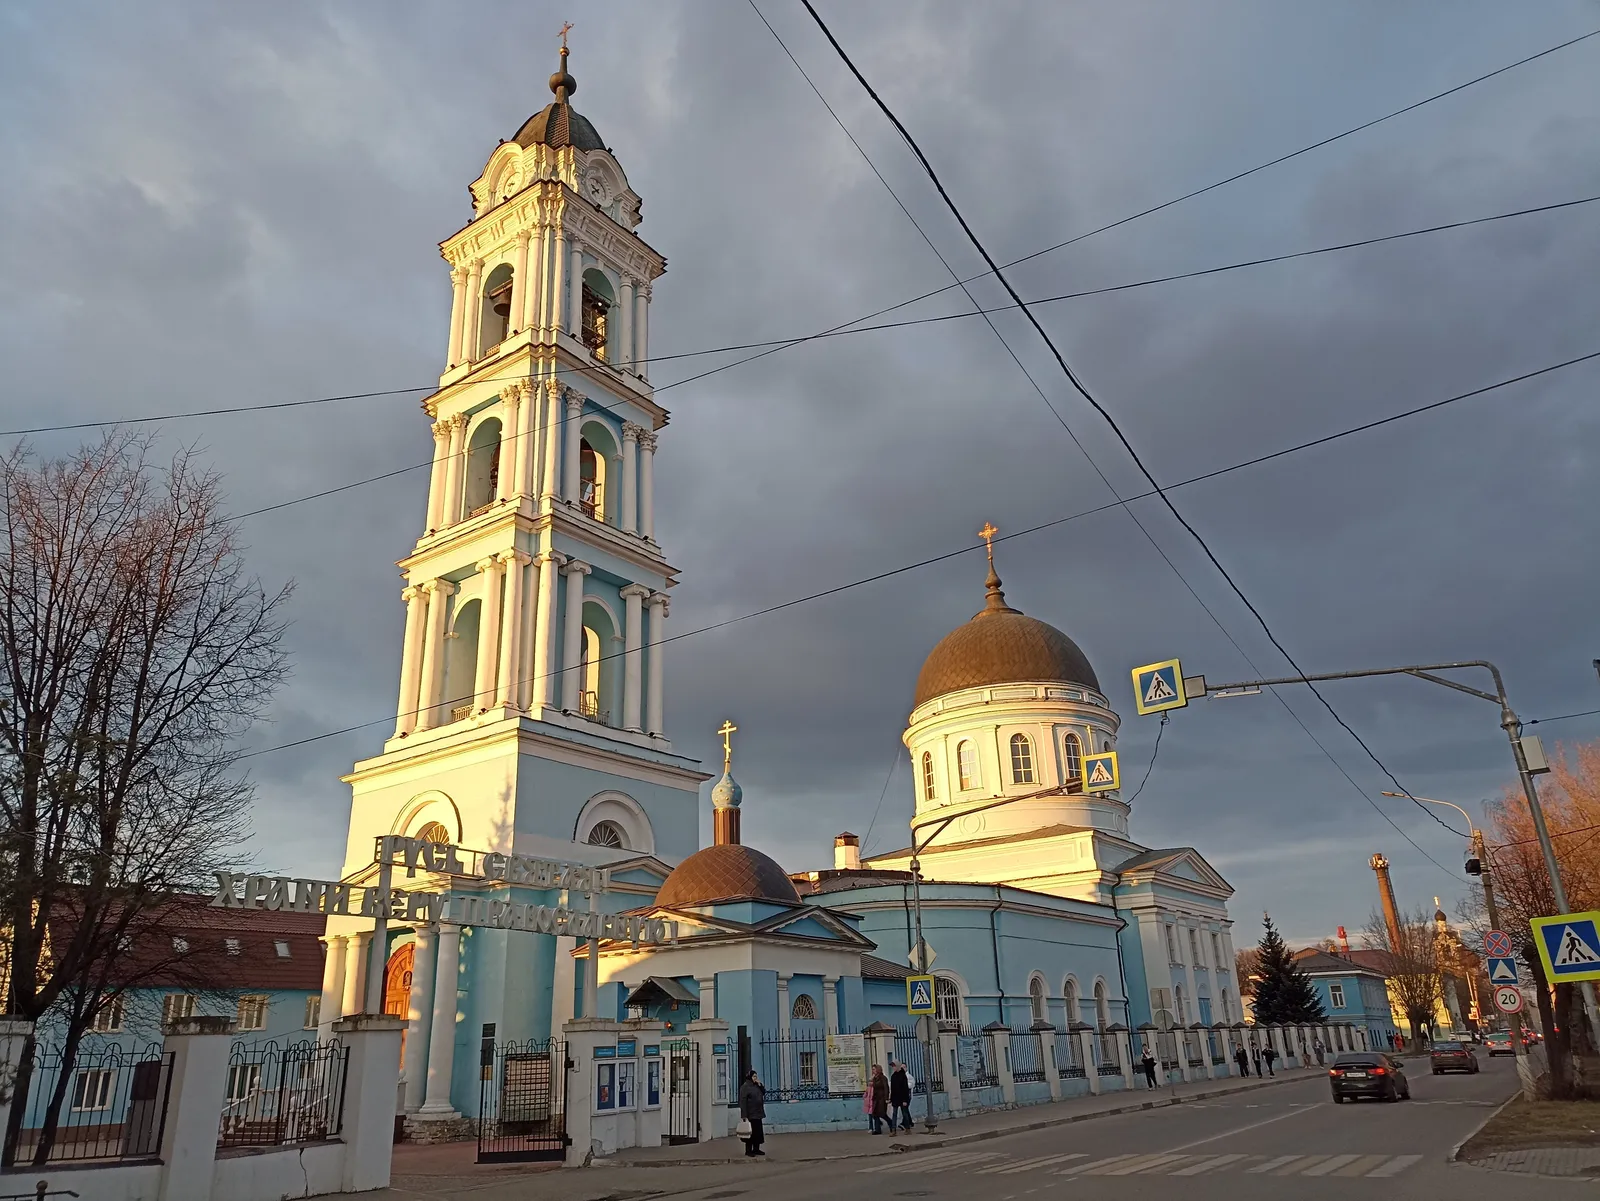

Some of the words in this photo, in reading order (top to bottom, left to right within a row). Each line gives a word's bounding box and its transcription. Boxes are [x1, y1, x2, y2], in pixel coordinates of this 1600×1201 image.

[382, 835, 464, 877] РУСЬ
[207, 870, 351, 915] ХРАНИ
[361, 886, 449, 932] ВЕРУ
[1501, 994, 1516, 1005] 20
